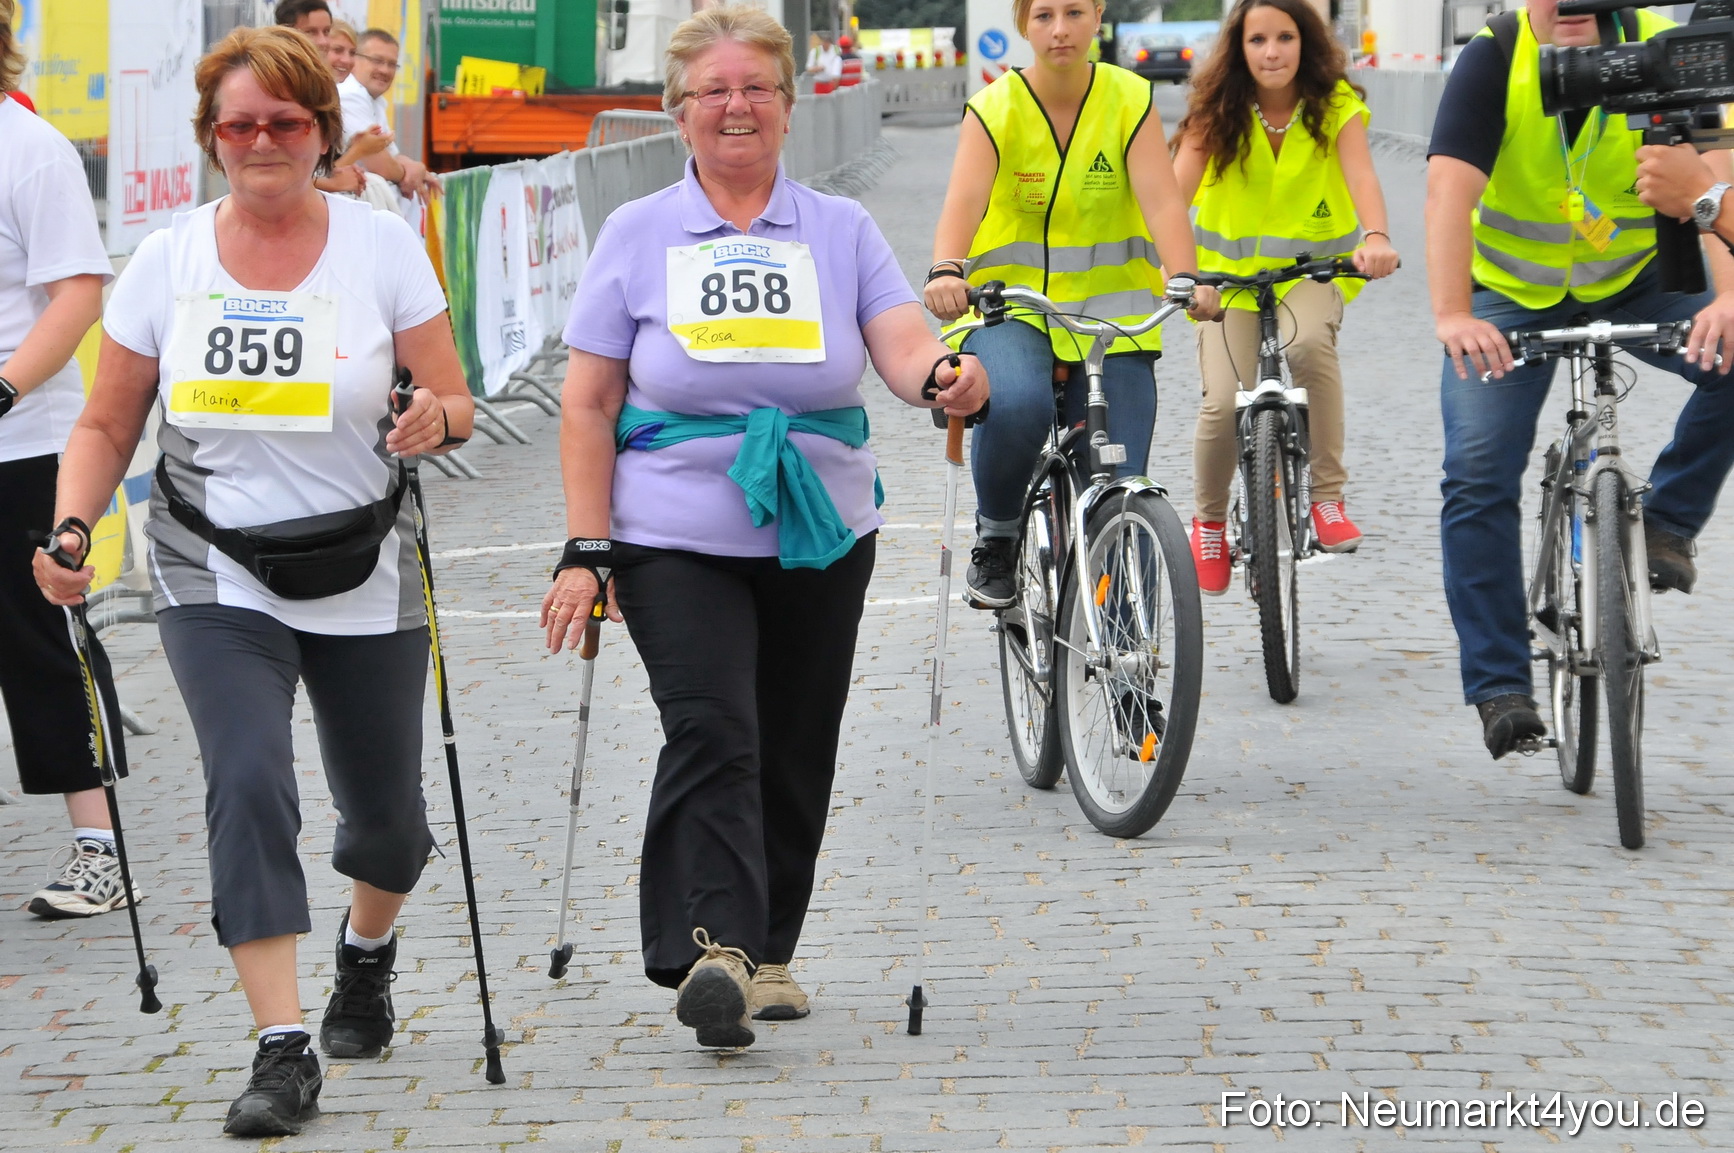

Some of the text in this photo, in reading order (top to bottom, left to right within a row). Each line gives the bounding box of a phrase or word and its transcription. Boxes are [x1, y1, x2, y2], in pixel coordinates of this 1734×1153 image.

[714, 244, 771, 259] BOCK
[700, 269, 791, 316] 858
[224, 298, 288, 313] BOCK
[691, 327, 736, 345] Rosa
[204, 326, 303, 377] 859
[192, 388, 241, 408] Maria
